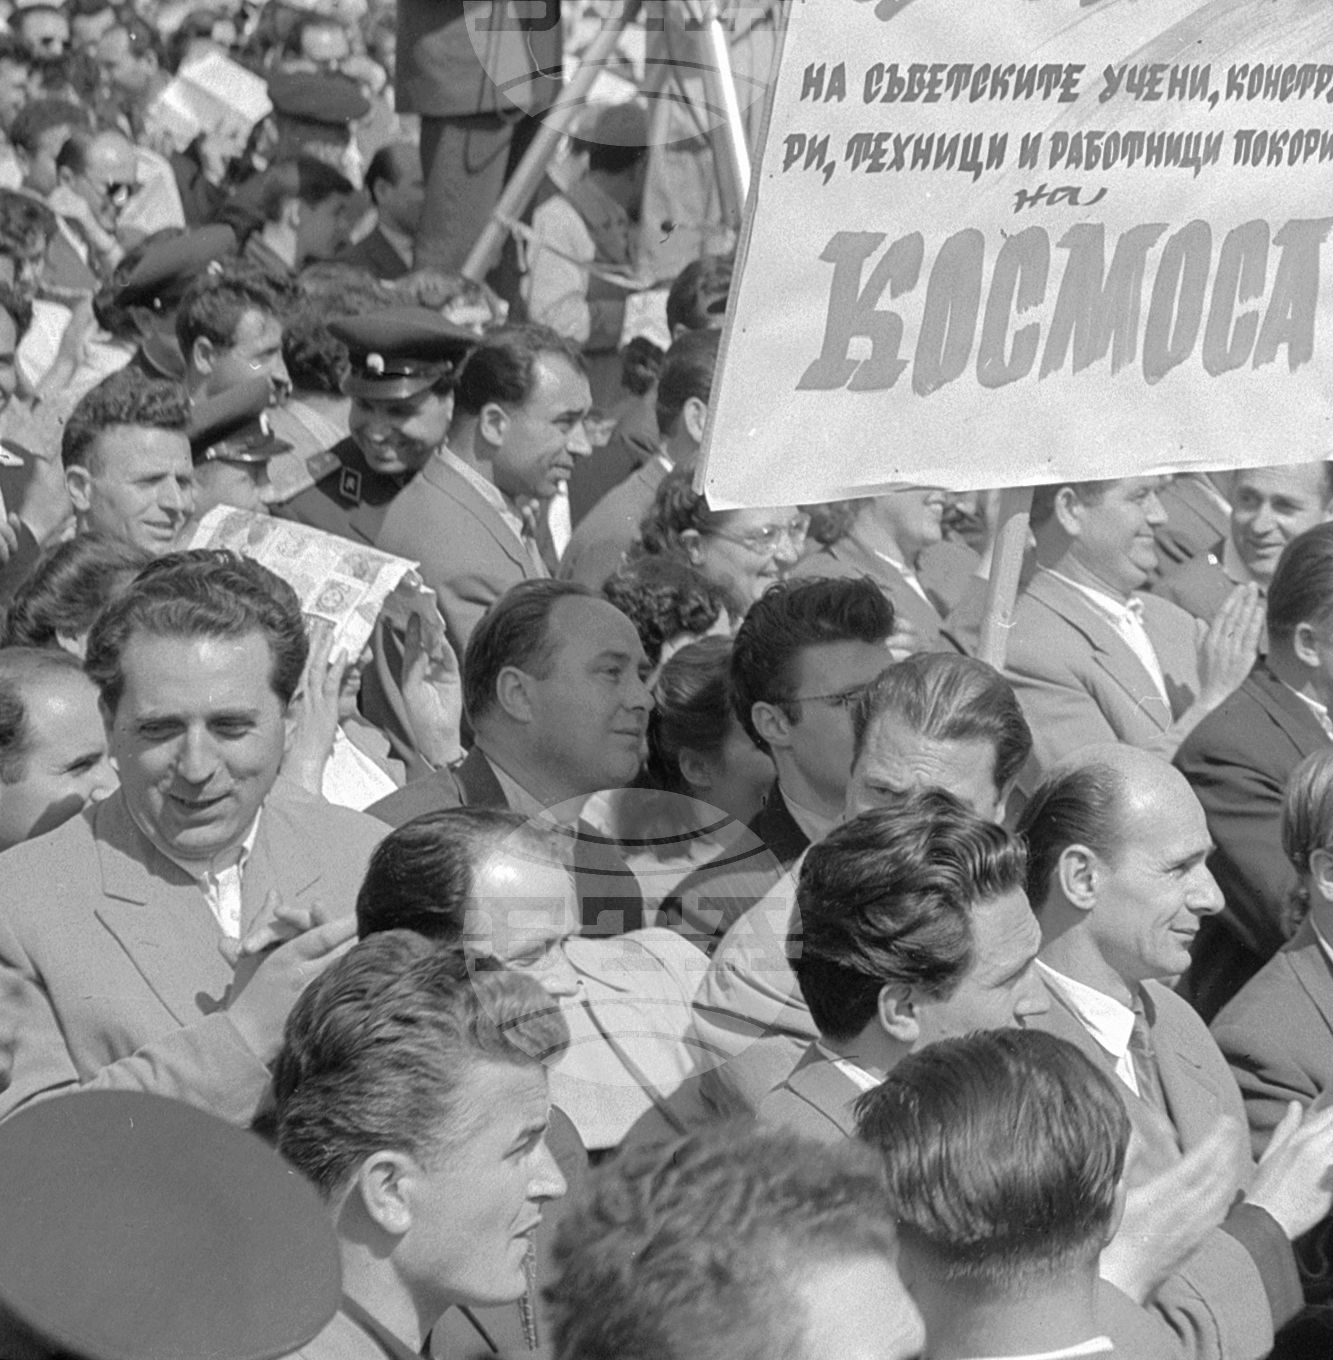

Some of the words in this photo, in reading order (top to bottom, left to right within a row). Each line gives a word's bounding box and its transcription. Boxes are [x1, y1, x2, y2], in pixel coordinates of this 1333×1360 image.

[801, 64, 845, 104] НА
[863, 63, 1080, 104] СЪВЕТСКИТЕ
[1100, 64, 1218, 111] УЧЕНИ,
[782, 132, 836, 185] РИ,
[844, 131, 1007, 181] ТЕХНИЦИ
[1019, 132, 1039, 170] И
[1049, 130, 1221, 179] РАБОТНИЦИ
